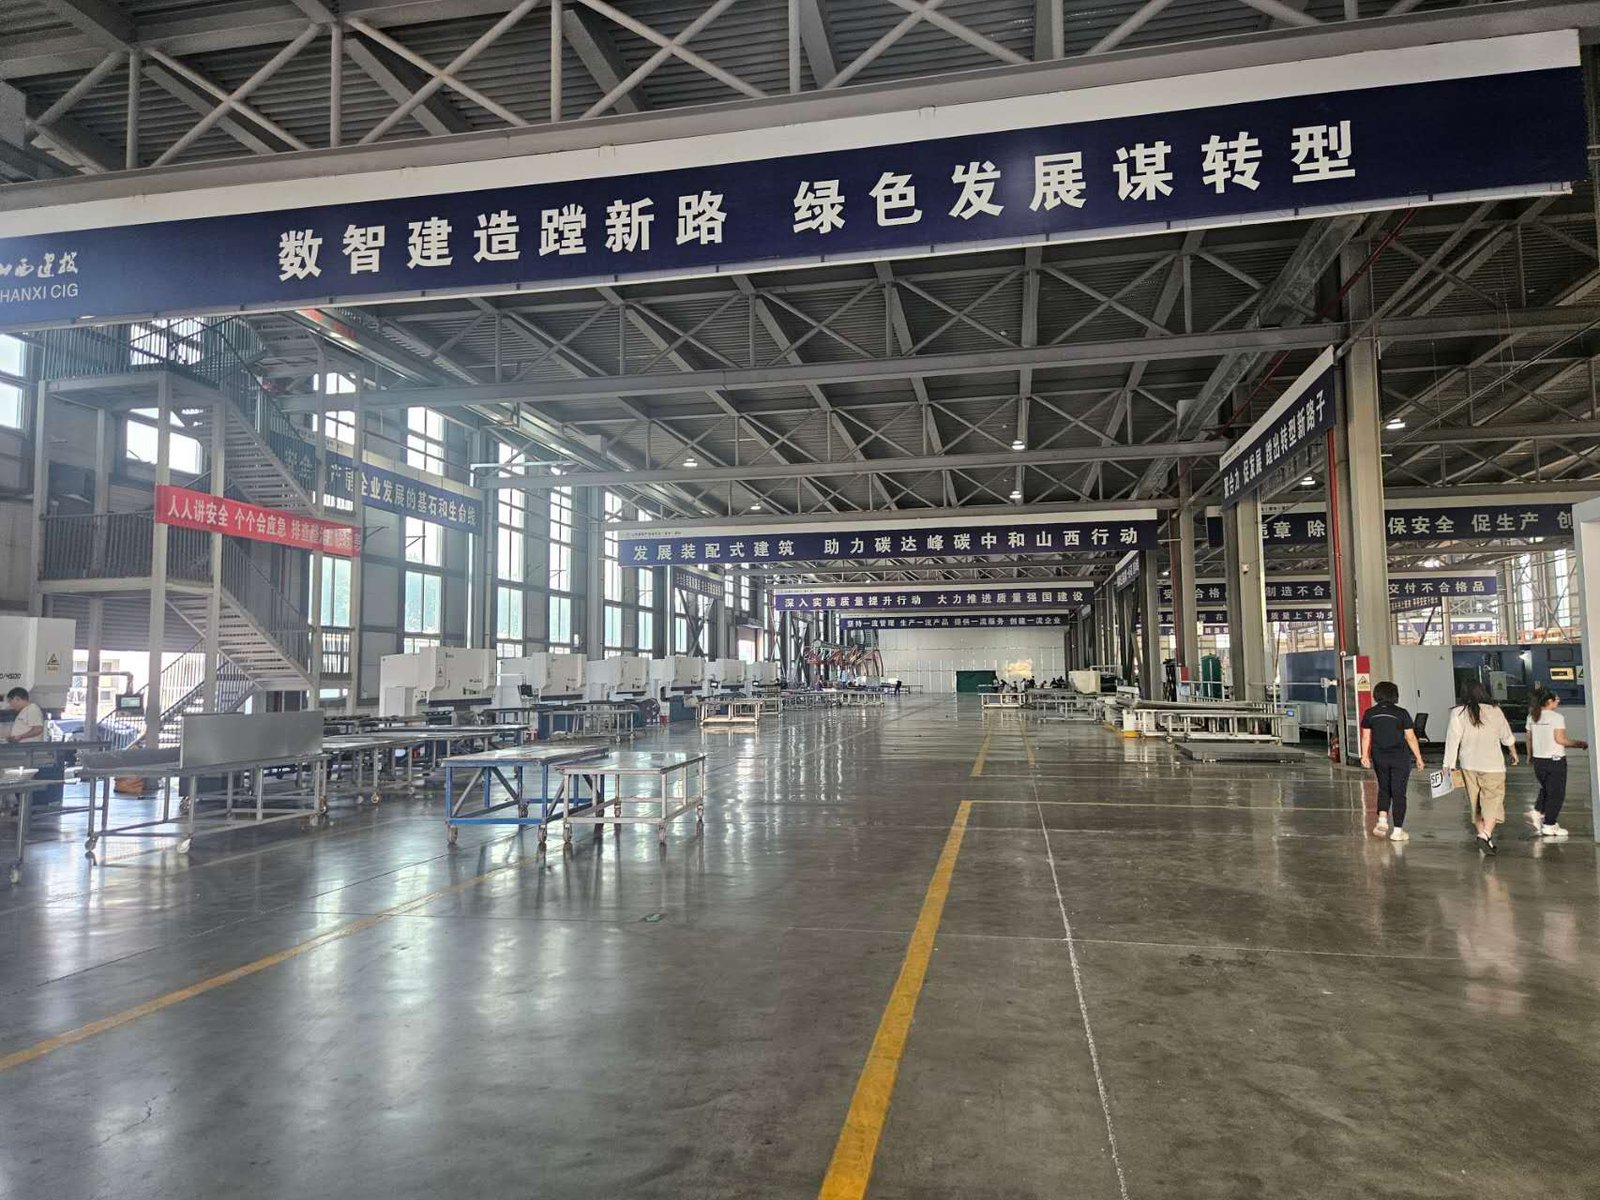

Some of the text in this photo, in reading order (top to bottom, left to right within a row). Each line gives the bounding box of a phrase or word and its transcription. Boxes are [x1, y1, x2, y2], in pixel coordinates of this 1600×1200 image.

[278, 120, 1356, 282] 数智建造蹚新路 绿色发展谋转型
[51, 283, 78, 298] CIG
[1243, 448, 1262, 485] 促发展
[168, 495, 229, 526] 人人讲安全
[235, 508, 287, 538] 个个会应急
[1388, 515, 1455, 535] 保安全
[1471, 512, 1539, 533] 促生产
[633, 527, 1138, 561] 发展装配式建筑 助力碳达峰碳中和山西行动
[784, 591, 1084, 608] 深入实施质量提升行动 大力推进质量强国建设
[1388, 580, 1485, 595] 交付不合格品
